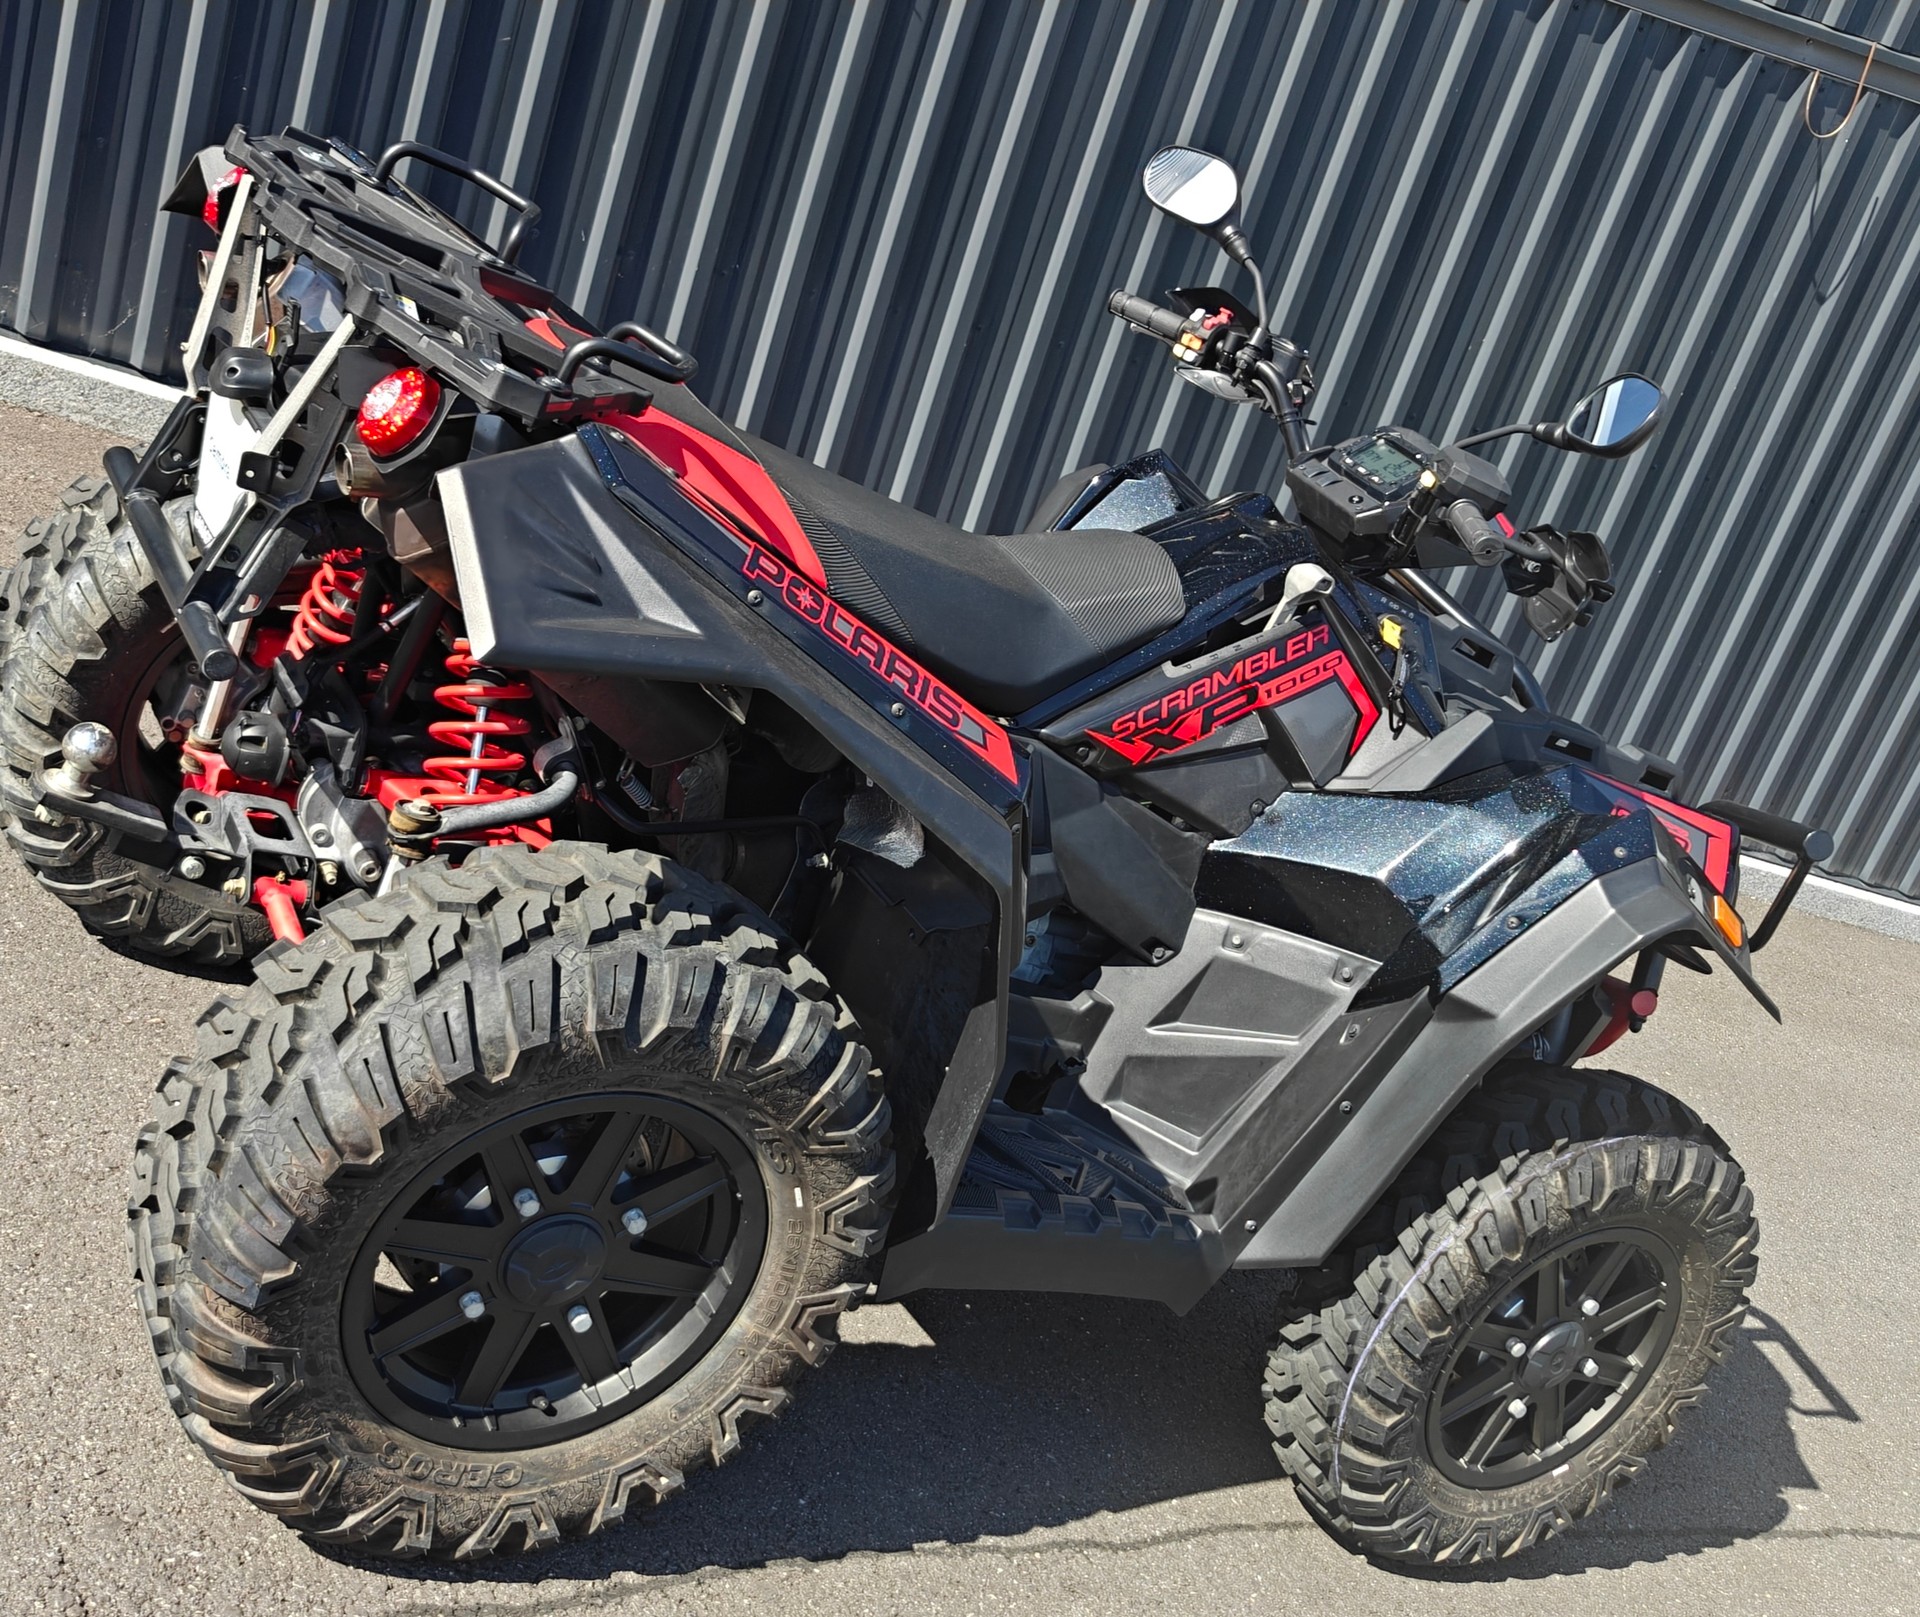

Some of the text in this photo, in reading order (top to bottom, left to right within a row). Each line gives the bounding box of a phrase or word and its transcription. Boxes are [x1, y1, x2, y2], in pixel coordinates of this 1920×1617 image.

[742, 542, 967, 731] POLARIS
[1112, 624, 1330, 734] SCRAMBLER
[1130, 654, 1343, 765] XP 1000
[378, 1441, 523, 1488] CEROS
